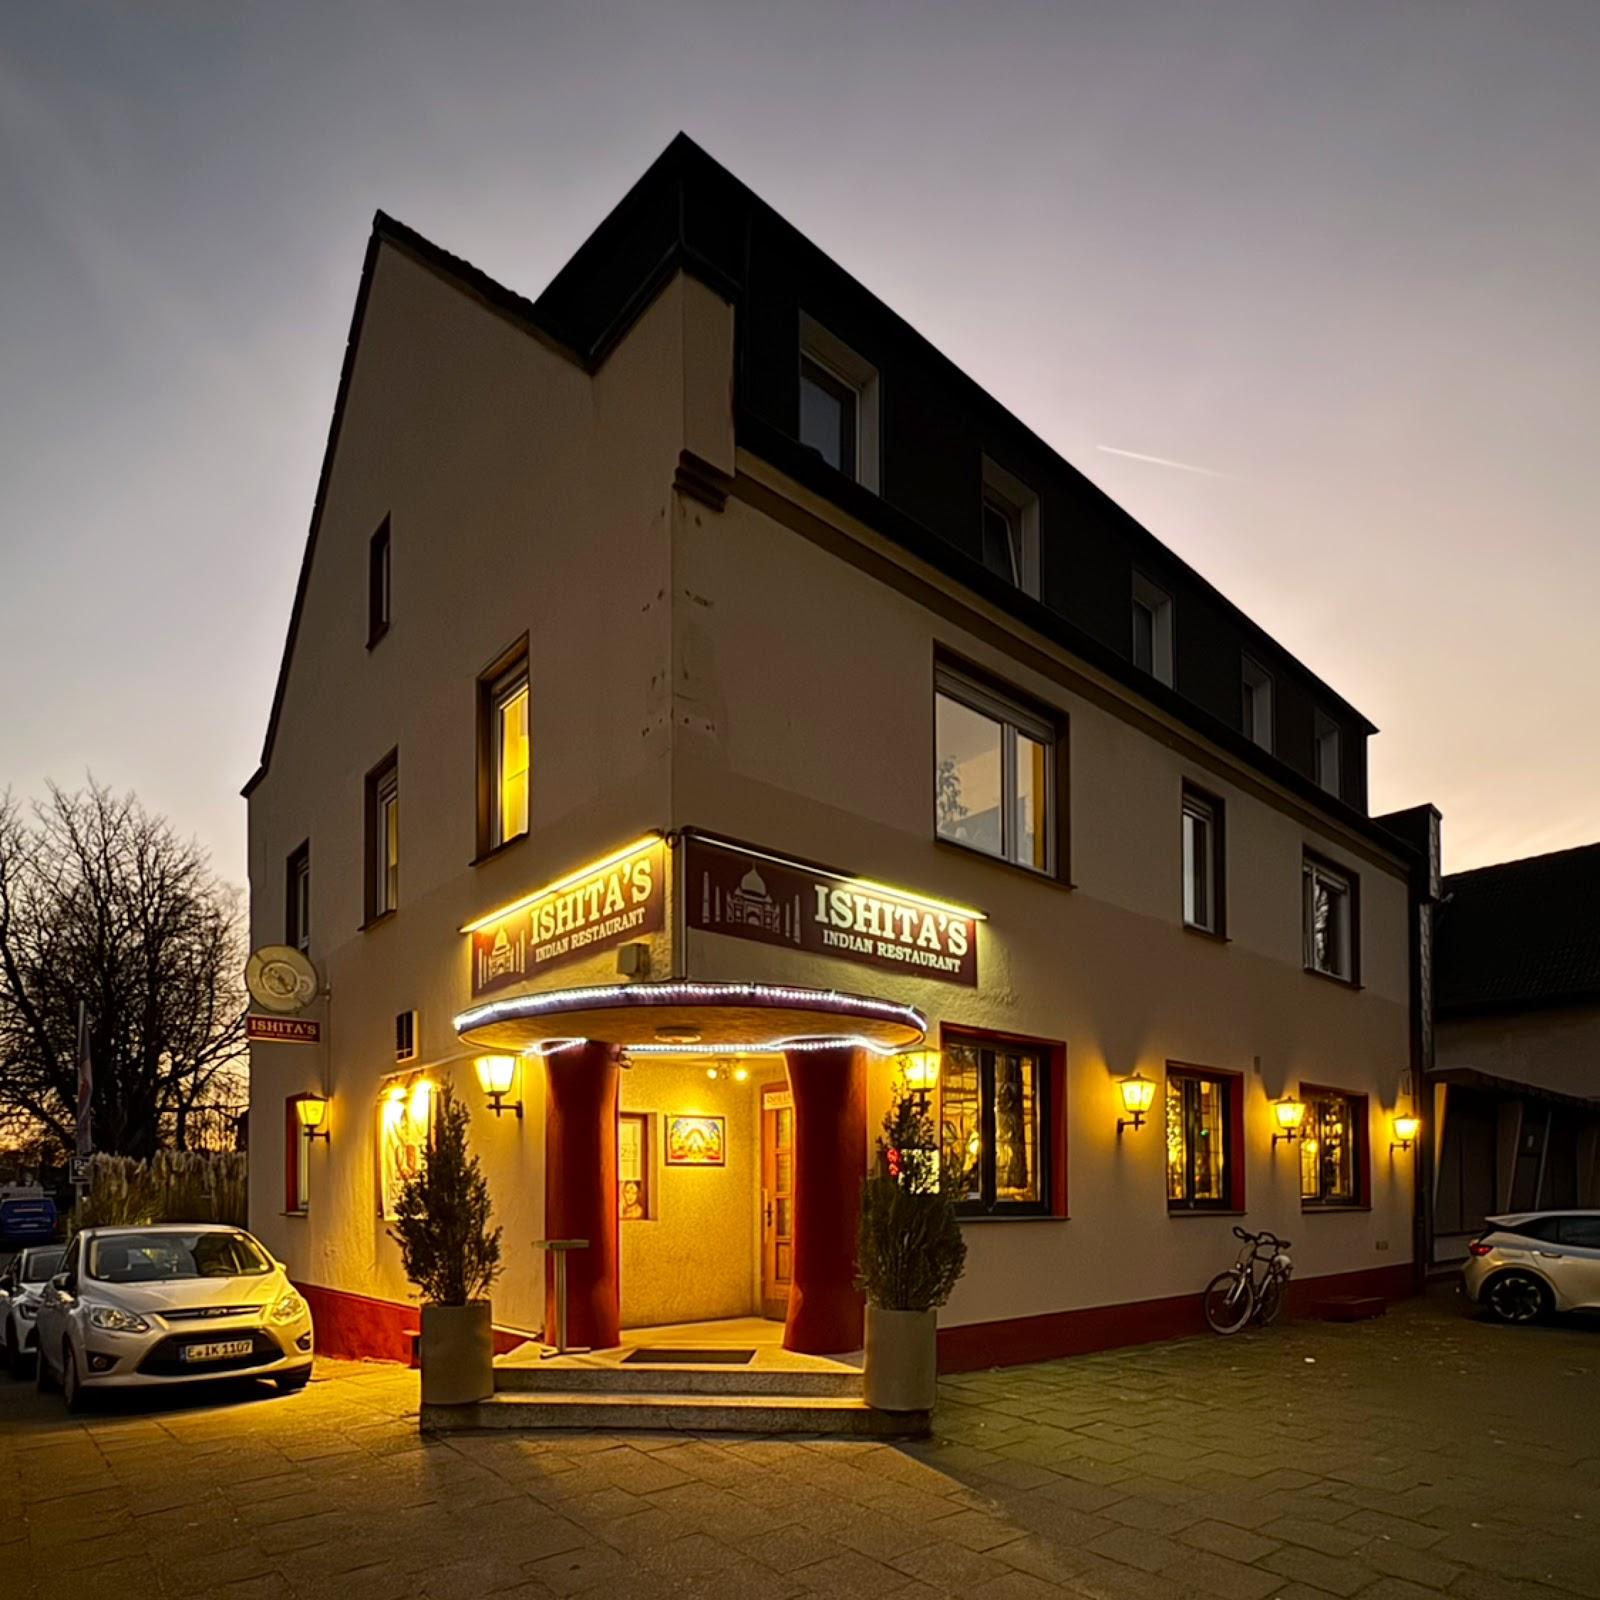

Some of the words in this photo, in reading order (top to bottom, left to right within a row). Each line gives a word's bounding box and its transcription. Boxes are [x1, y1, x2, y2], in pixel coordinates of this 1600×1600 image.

[530, 858, 652, 945] ISHITA'S
[814, 884, 968, 956] ISHITA'S
[535, 938, 569, 962] INDIAN
[571, 907, 646, 950] RESTAURANT
[823, 929, 873, 954] INDIAN
[877, 941, 961, 973] RESTAURANT
[251, 1019, 317, 1036] ISHITA'S
